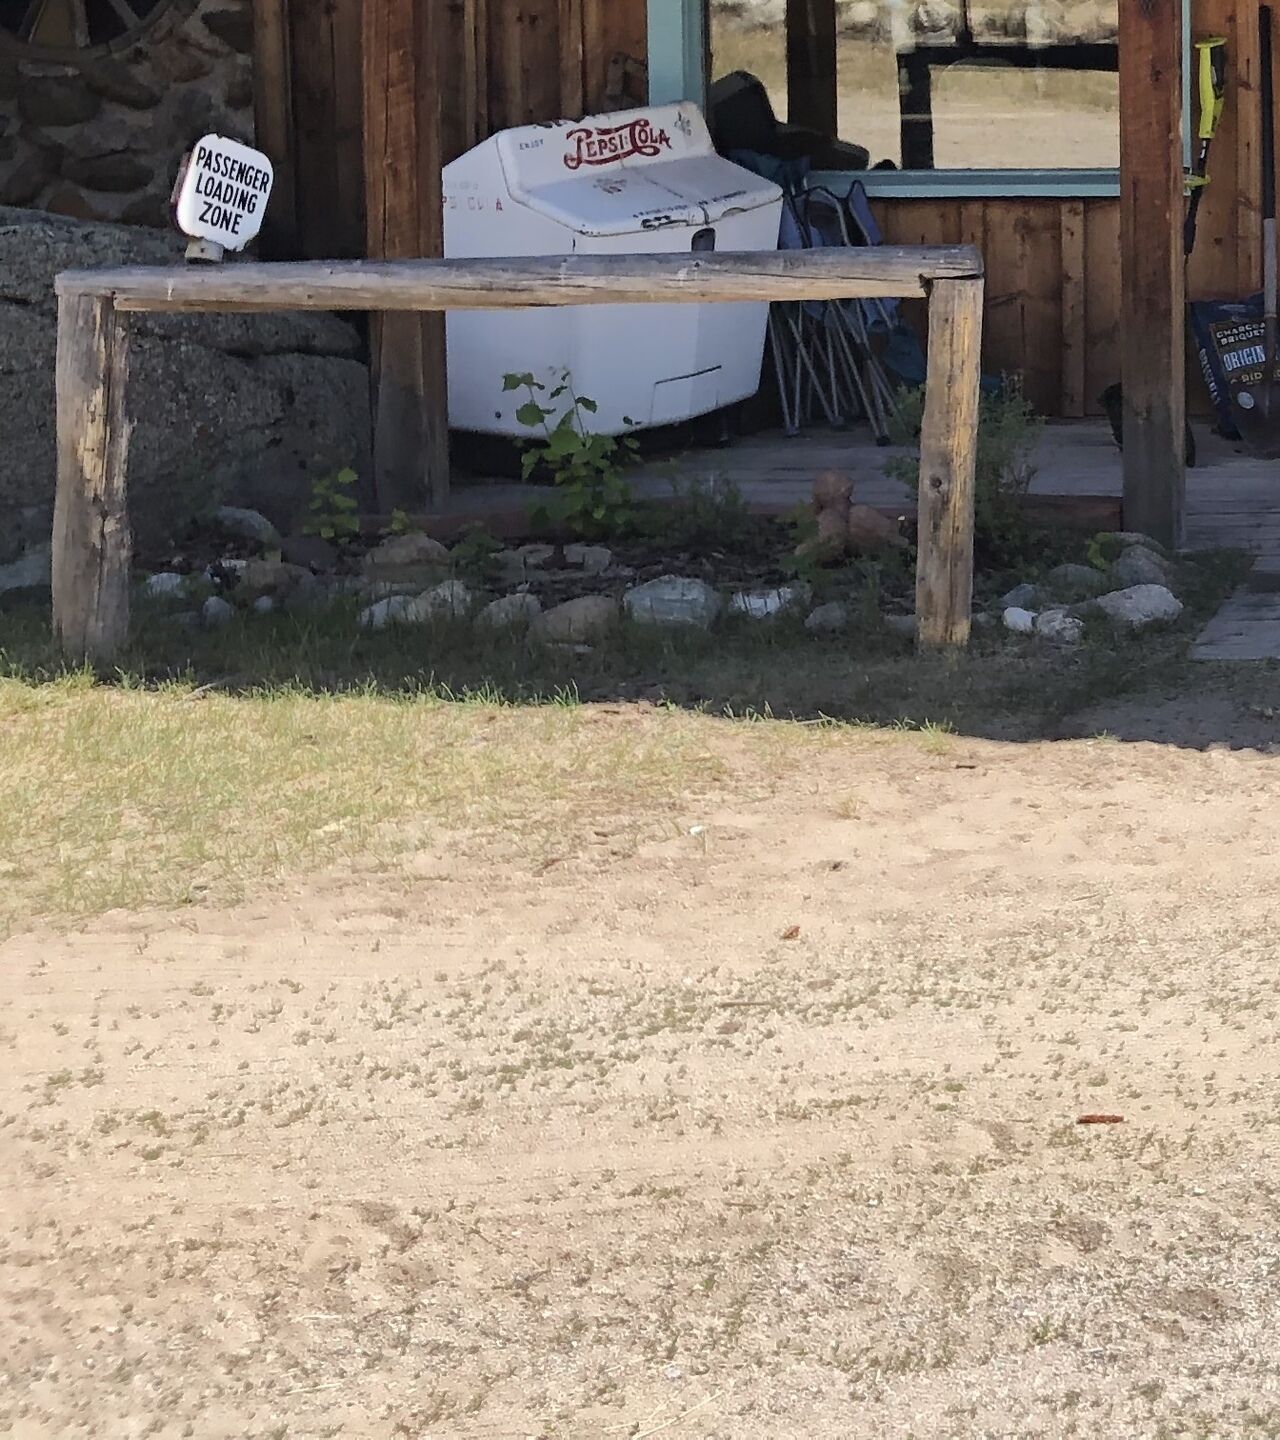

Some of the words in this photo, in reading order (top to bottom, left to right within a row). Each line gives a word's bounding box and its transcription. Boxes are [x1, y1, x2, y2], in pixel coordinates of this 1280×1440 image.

[196, 146, 270, 194] PASSENGER
[195, 172, 258, 214] LOADING
[198, 200, 243, 235] ZONE
[1216, 322, 1266, 339] CHARCOA
[1220, 329, 1265, 345] BRIQUET
[1223, 345, 1266, 371] ORIGIN
